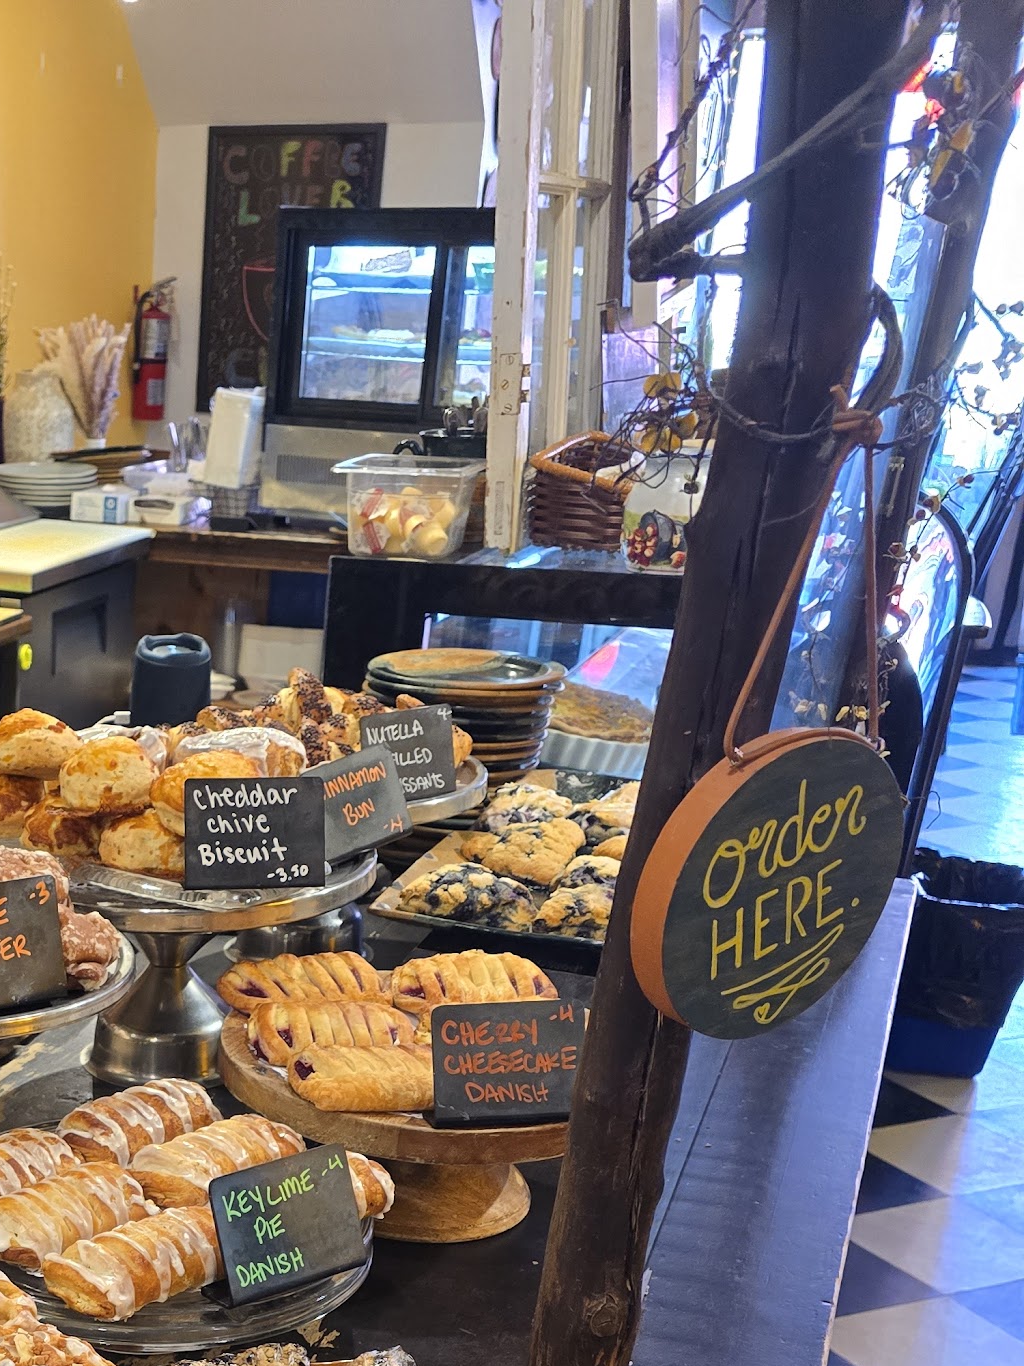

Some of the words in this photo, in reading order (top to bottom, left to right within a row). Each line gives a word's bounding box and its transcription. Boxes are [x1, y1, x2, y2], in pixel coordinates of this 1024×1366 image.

[223, 139, 363, 184] COFFEE
[365, 718, 424, 746] NUTELLA
[324, 761, 387, 799] INNAMON
[342, 798, 376, 826] BUN
[198, 837, 287, 868] Biscuit
[440, 1019, 538, 1046] CHERRY
[443, 1046, 576, 1075] CHEESECAKE
[464, 1081, 549, 1103] DANISH
[253, 1213, 286, 1245] PIE
[235, 1246, 305, 1288] DANISH
